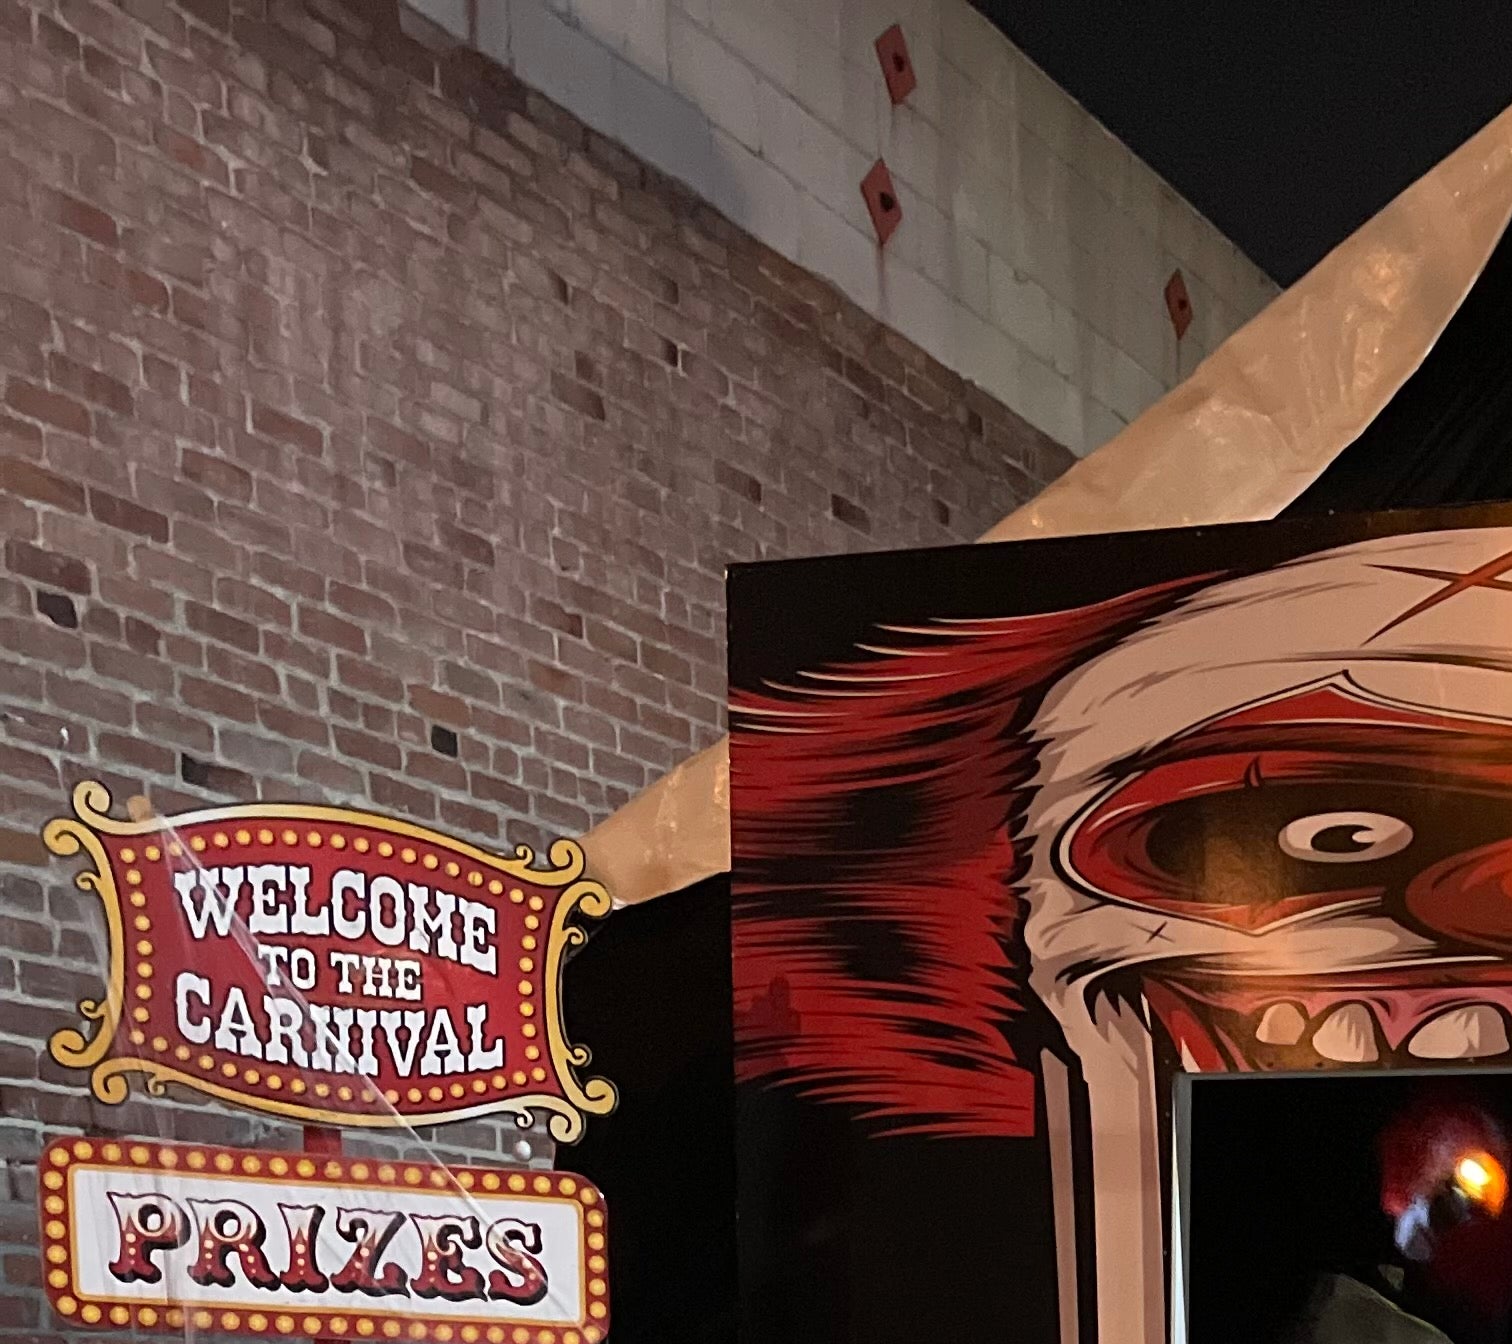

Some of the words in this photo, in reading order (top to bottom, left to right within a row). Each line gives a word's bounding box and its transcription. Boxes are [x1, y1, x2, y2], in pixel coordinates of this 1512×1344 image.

[173, 864, 499, 975] WELCOME
[256, 942, 317, 990] TO
[330, 952, 422, 1001] THE
[175, 971, 504, 1077] CARNIVAL
[107, 1191, 549, 1306] PRIZES
